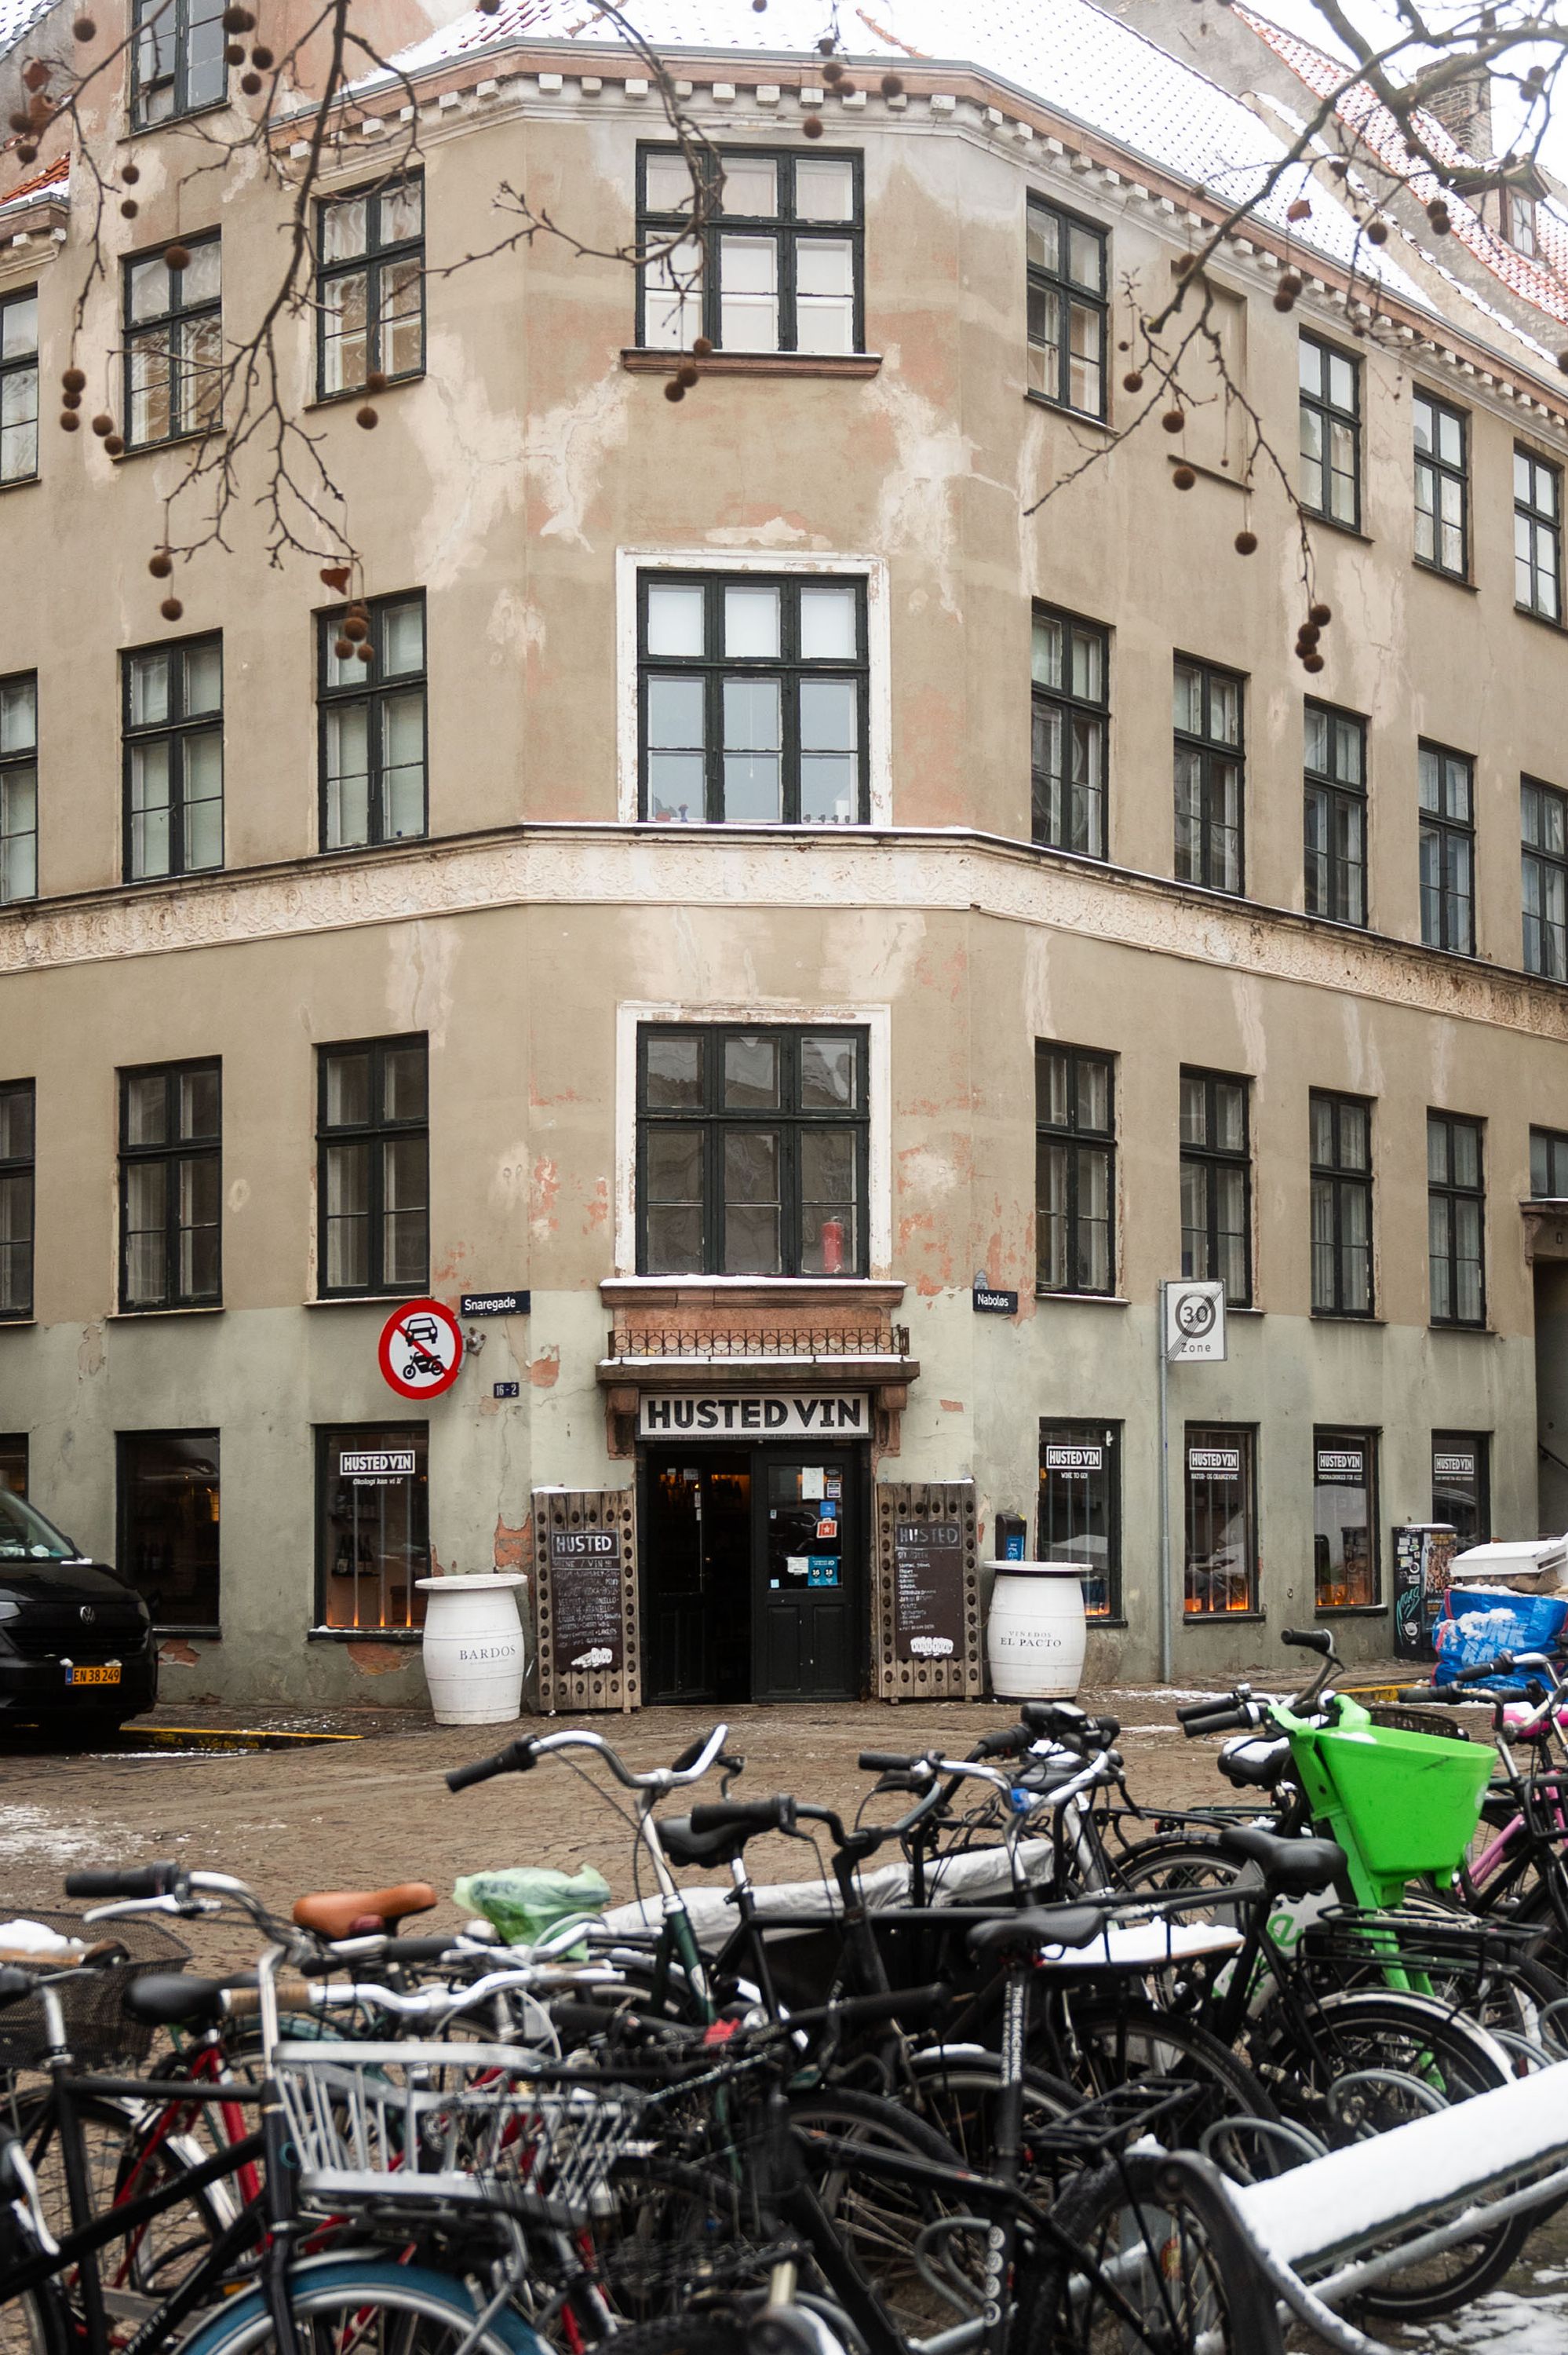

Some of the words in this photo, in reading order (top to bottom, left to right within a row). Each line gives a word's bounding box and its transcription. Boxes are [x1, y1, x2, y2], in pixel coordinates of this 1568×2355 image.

[465, 1297, 516, 1312] Snaregade
[977, 1294, 1009, 1307] Naboløs
[1183, 1305, 1208, 1324] 30
[1181, 1342, 1211, 1353] Zone
[511, 1384, 517, 1396] 2
[647, 1399, 789, 1429] HUSTED
[793, 1399, 861, 1428] VIN
[344, 1455, 388, 1471] HUSTED
[388, 1455, 411, 1470] VIN
[1049, 1450, 1082, 1465] HUSTED
[1082, 1451, 1099, 1465] VIN
[1192, 1453, 1222, 1466] HUSTED
[1222, 1454, 1237, 1466] VIN
[1320, 1455, 1347, 1468] HUSTED
[1347, 1455, 1360, 1468] VIN
[1436, 1458, 1460, 1470] HUSTED
[1460, 1459, 1471, 1470] VIN
[899, 1527, 958, 1544] HUSTED
[556, 1535, 612, 1553] HUSTED
[1019, 1638, 1062, 1647] PACTO
[460, 1645, 516, 1660] BARDOS
[74, 1670, 87, 1682] EN
[89, 1669, 100, 1682] 38
[102, 1669, 120, 1681] 249
[1011, 2017, 1023, 2083] MACHINE
